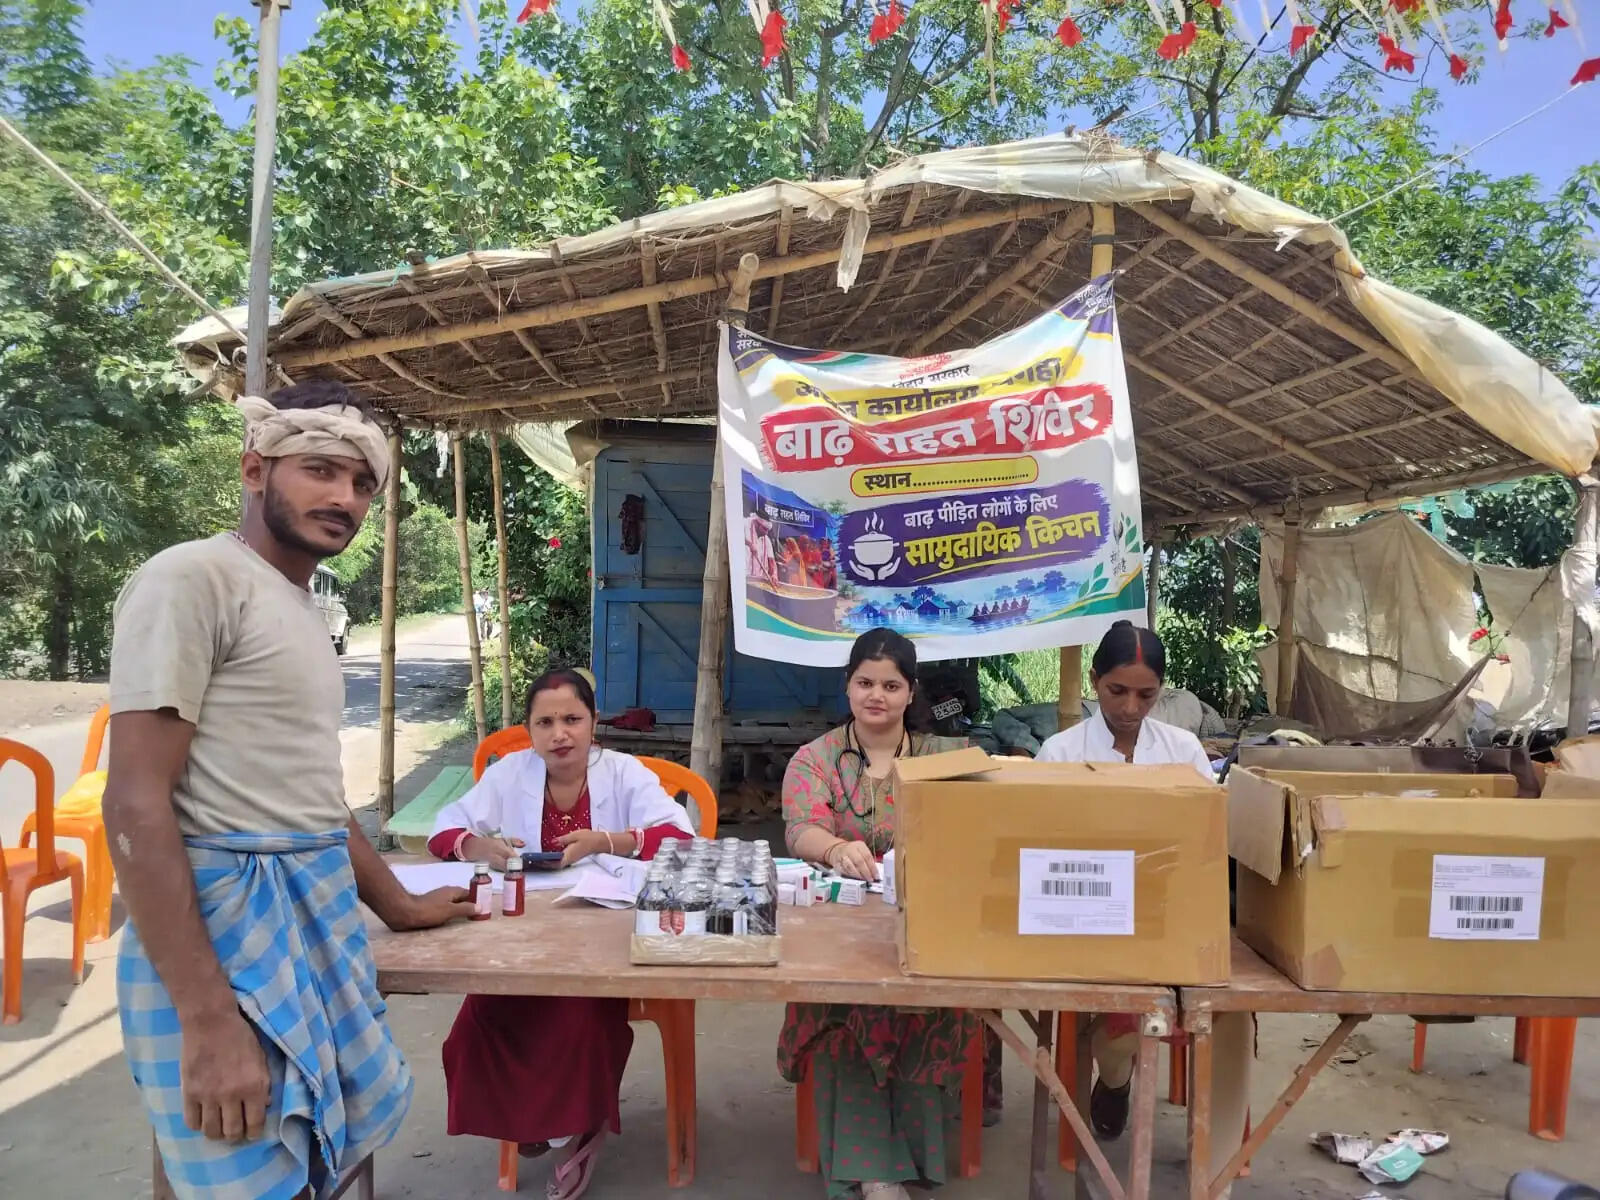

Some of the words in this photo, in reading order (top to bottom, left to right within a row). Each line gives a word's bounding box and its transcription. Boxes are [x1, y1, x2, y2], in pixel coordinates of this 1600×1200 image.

[928, 365, 971, 382] सरकार
[773, 420, 854, 466] बाढ़
[870, 418, 976, 455] राहत
[987, 391, 1099, 447] शिविर
[904, 509, 934, 531] बाढ़
[938, 503, 978, 527] पीड़ित
[982, 497, 1012, 517] लोगों
[1016, 497, 1028, 513] के
[1030, 494, 1059, 512] लिए
[903, 521, 1021, 569] सामुदायिक
[1026, 510, 1102, 549] किचन
